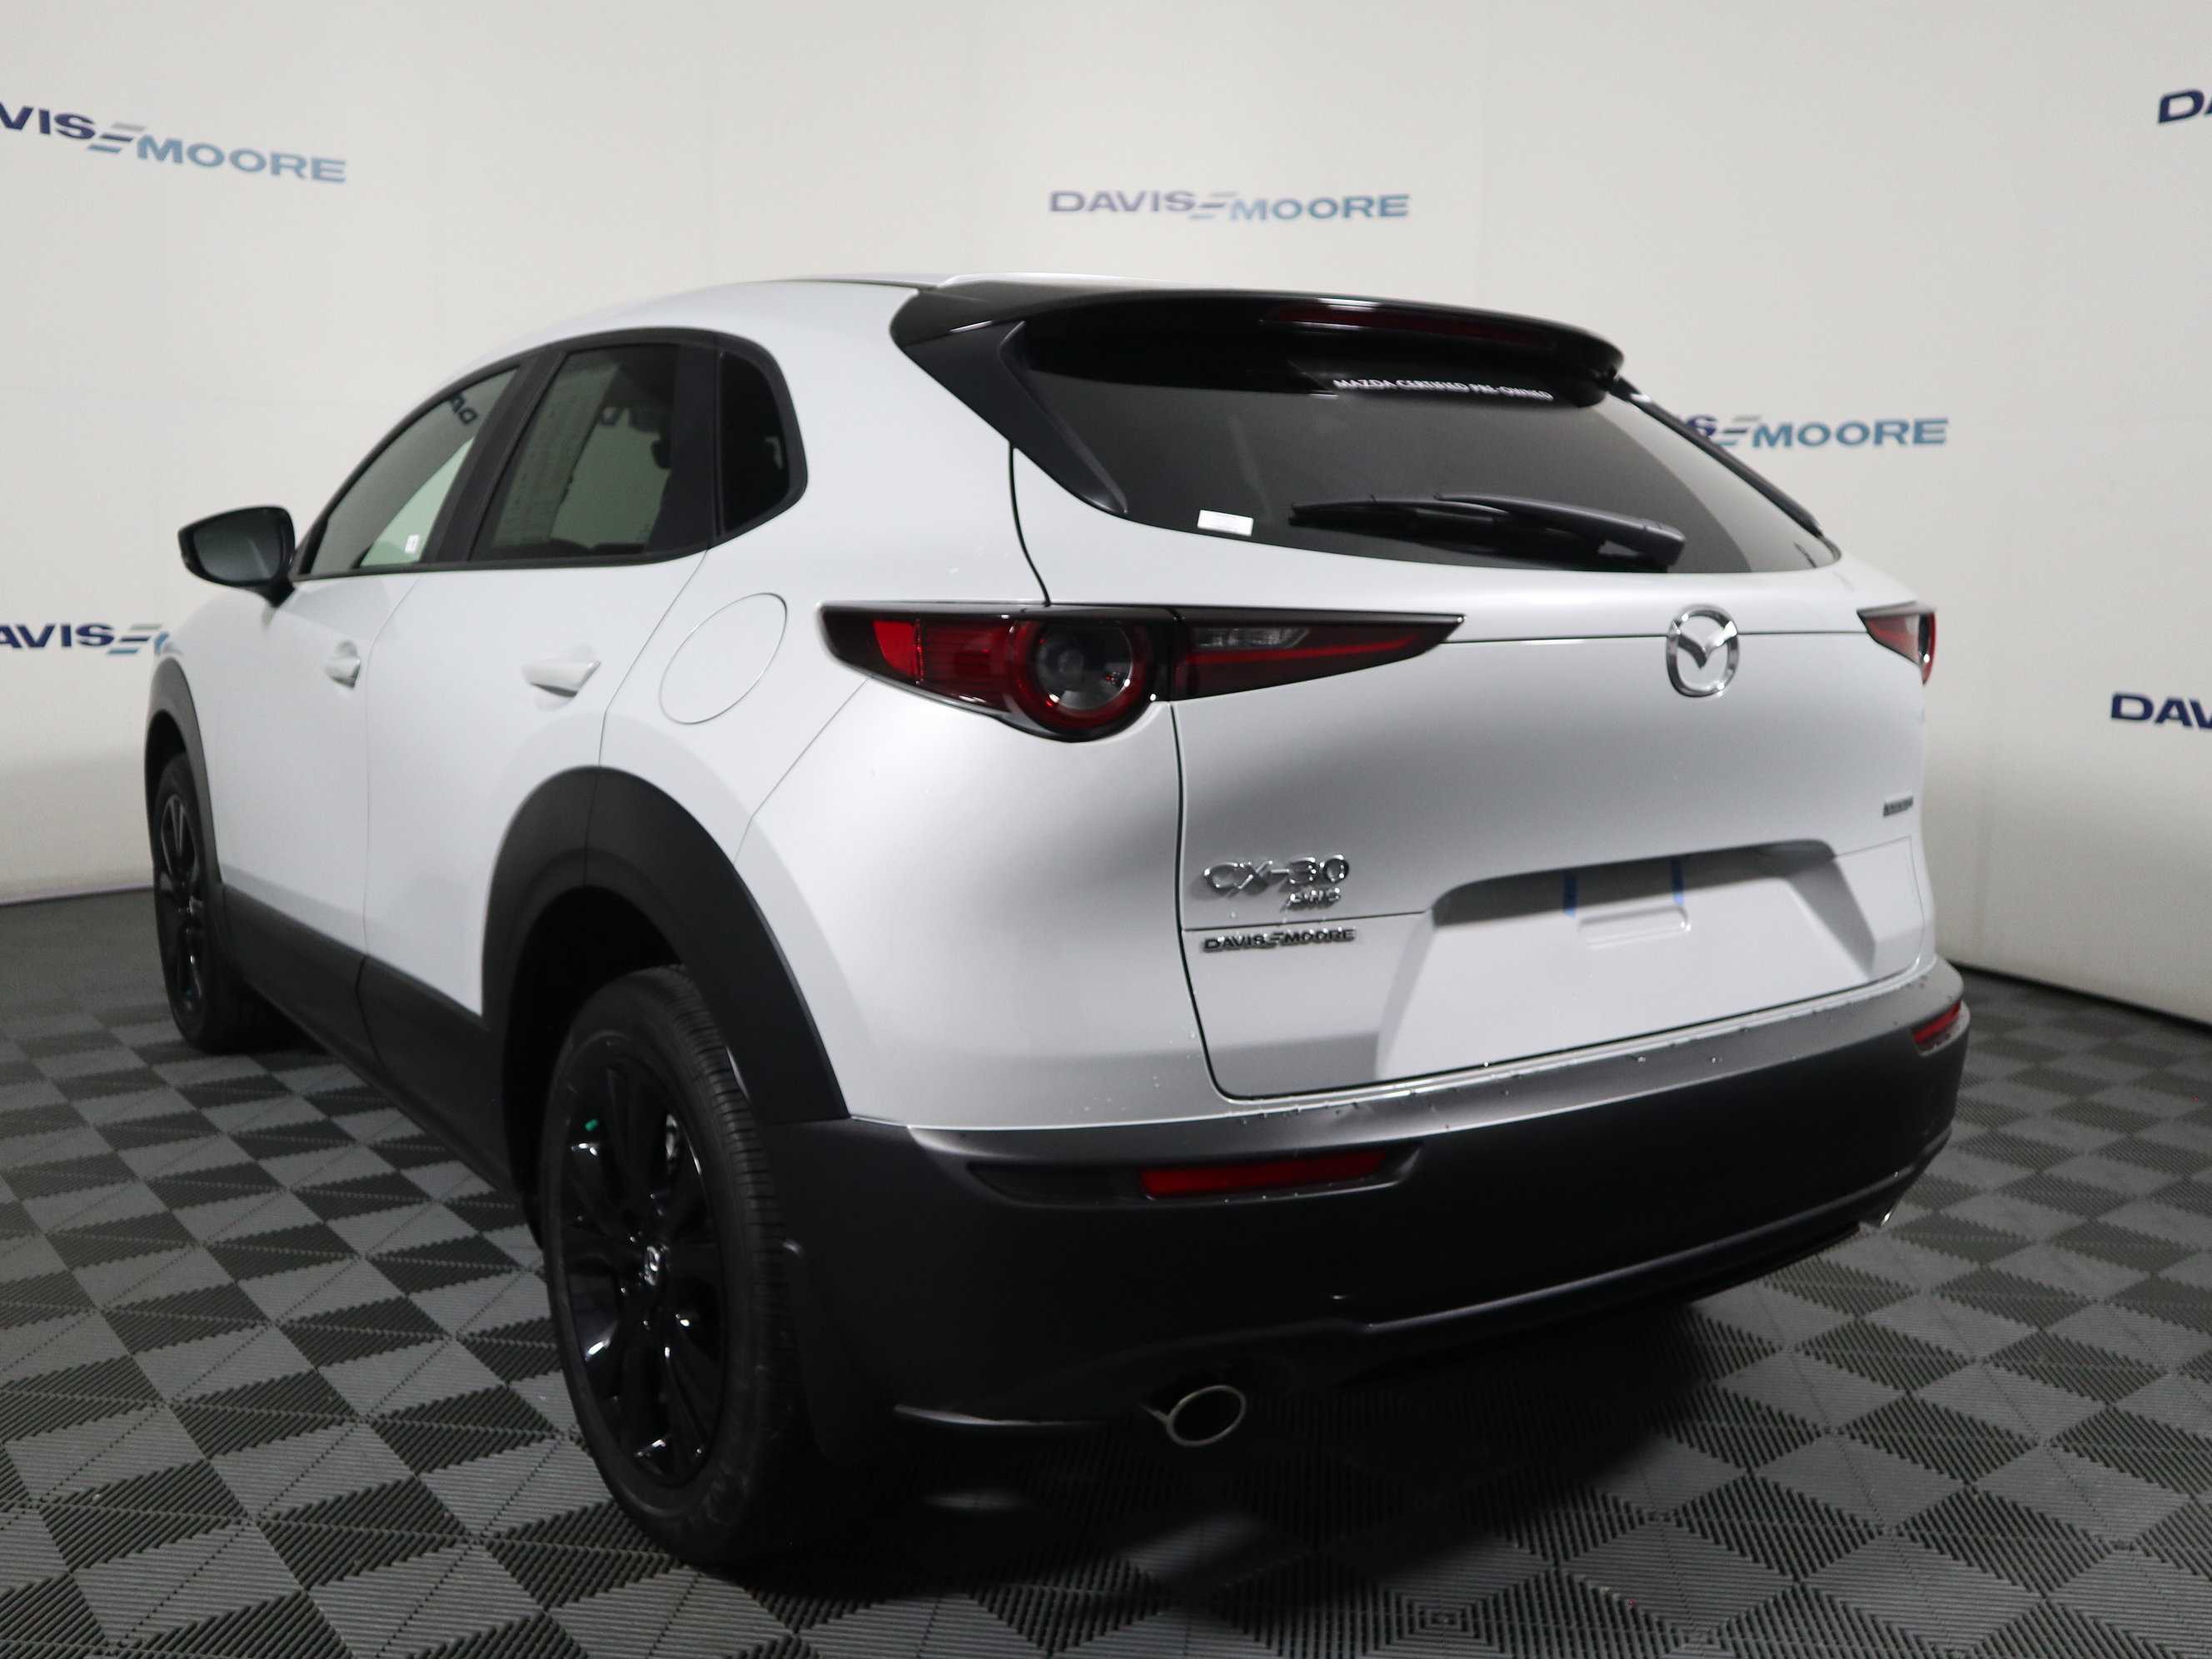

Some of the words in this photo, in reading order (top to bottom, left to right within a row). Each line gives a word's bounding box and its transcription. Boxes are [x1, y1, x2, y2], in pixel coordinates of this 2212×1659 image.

[2158, 88, 2212, 124] D
[137, 134, 346, 183] MOORE
[1049, 190, 1195, 213] DAVIS
[1228, 194, 1411, 220] MOORE
[1333, 379, 1397, 390] MAZDA
[1397, 380, 1470, 393] CERTIFIED
[1751, 416, 1949, 447] MOORE
[1203, 854, 1350, 892] CX-30
[1203, 934, 1266, 952] DAVIS
[1283, 927, 1357, 947] MOORE
